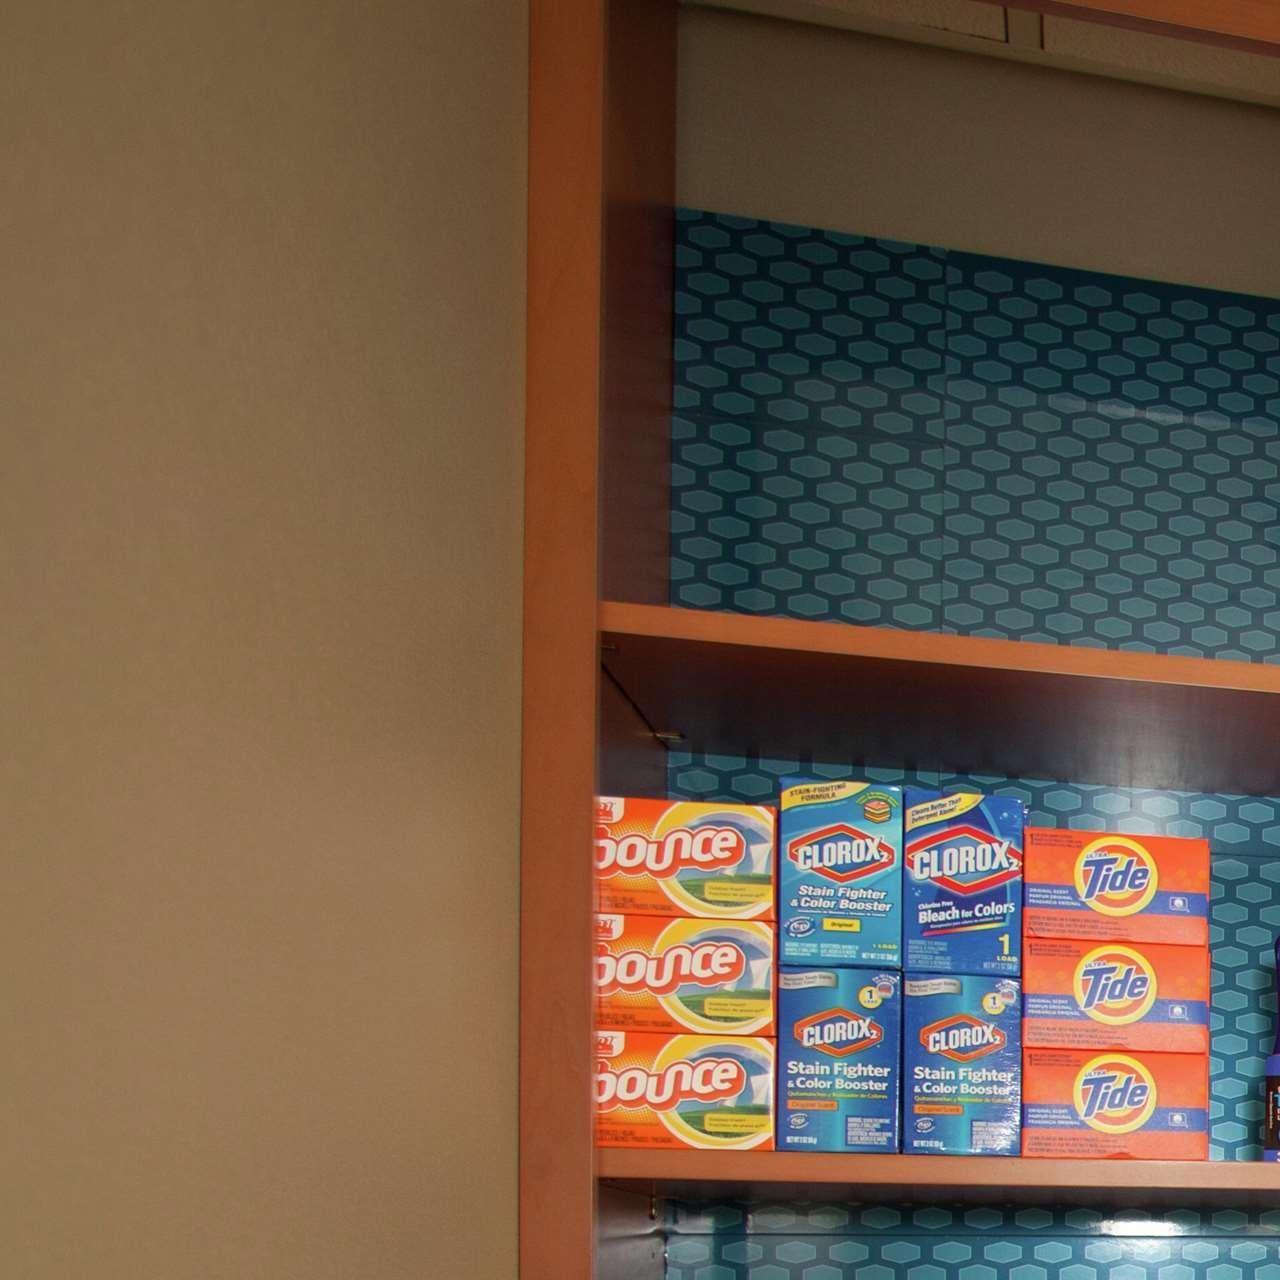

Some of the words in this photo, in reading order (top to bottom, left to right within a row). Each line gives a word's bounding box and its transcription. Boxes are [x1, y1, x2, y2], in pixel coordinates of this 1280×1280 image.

[1082, 857, 1150, 901] Tide
[799, 884, 834, 897] Stain
[837, 887, 888, 901] Fighter
[801, 897, 837, 909] Color
[839, 898, 892, 912] Booster
[918, 908, 960, 925] Bleach
[961, 909, 974, 919] for
[974, 902, 1016, 917] Colors
[998, 934, 1012, 955] 1
[1081, 966, 1149, 1011] Tide
[786, 1060, 830, 1076] Stain
[833, 1062, 892, 1079] Fighter
[913, 1067, 956, 1081] Stain
[958, 1068, 1014, 1085] Fighter
[795, 1076, 832, 1090] Color
[834, 1078, 889, 1092] Booster
[922, 1081, 959, 1096] Color
[960, 1083, 1014, 1098] Booster
[1081, 1074, 1149, 1120] Tide
